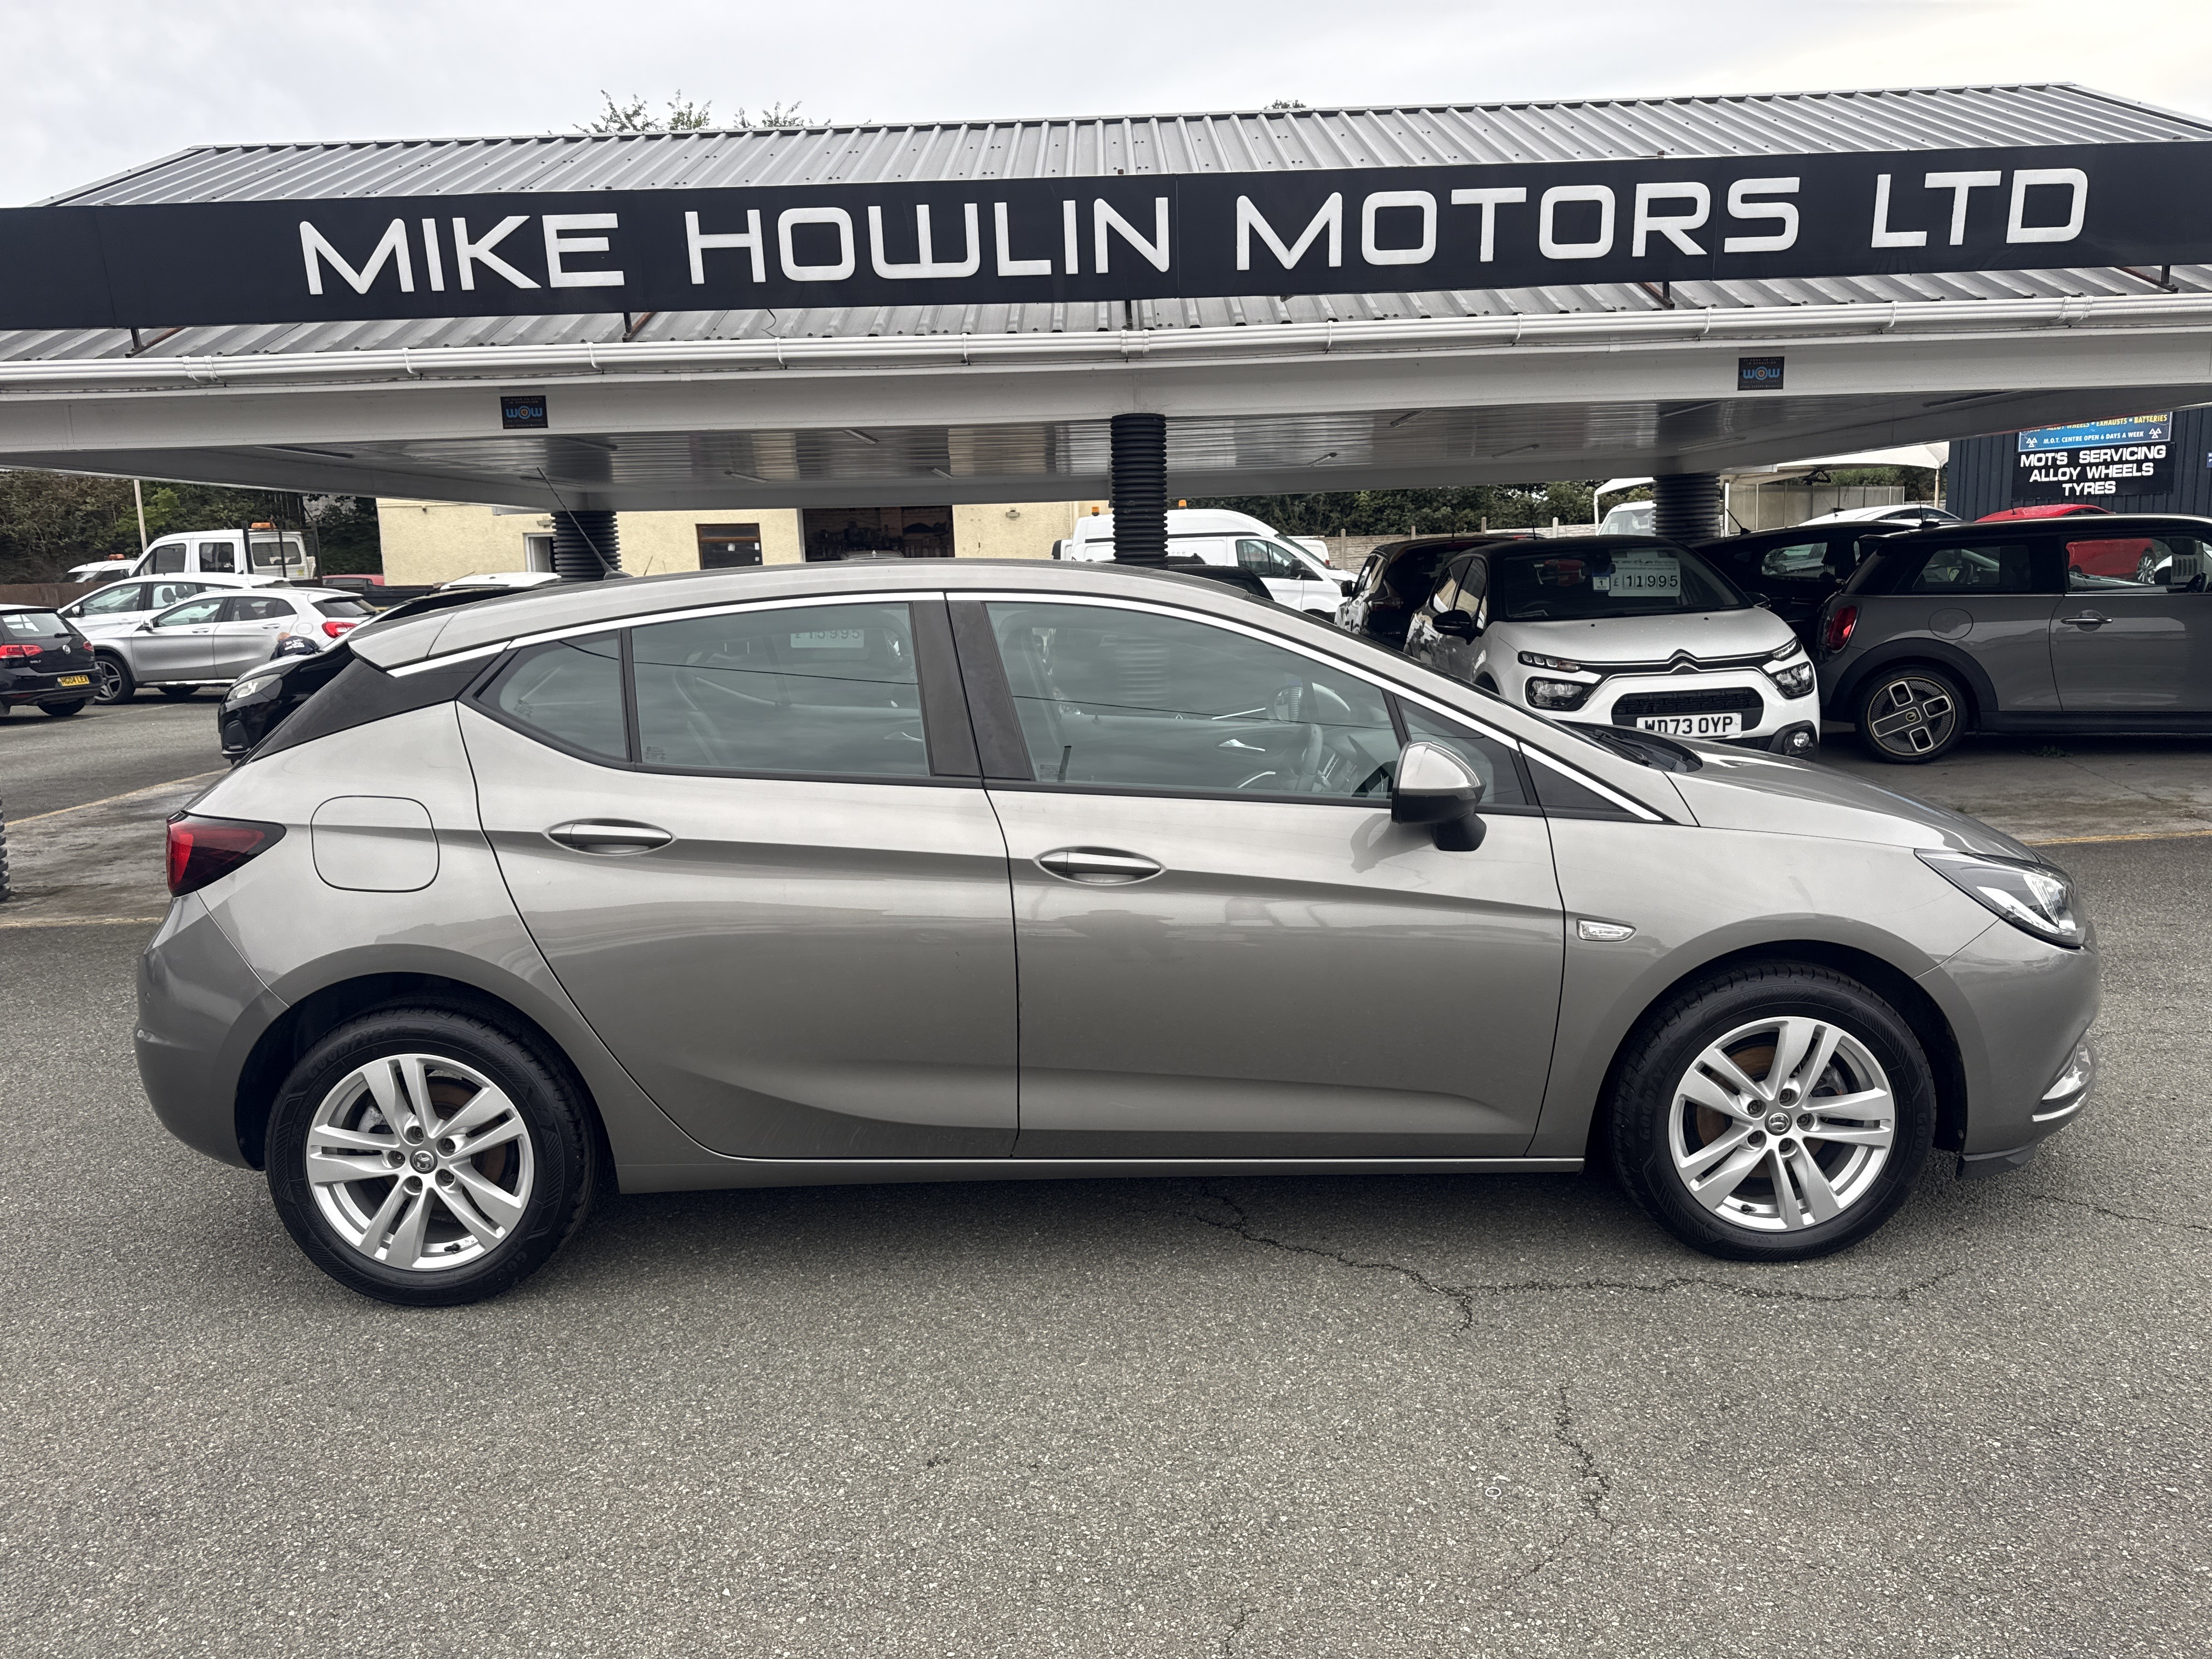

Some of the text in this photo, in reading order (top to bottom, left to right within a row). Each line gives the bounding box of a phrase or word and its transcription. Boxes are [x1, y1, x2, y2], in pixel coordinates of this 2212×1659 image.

[299, 168, 2088, 296] MIKE HOWLIN MOTORS LTD
[2096, 417, 2128, 427] EXHAUSTS
[2134, 414, 2168, 424] BATTERIES
[2020, 445, 2166, 467] MOT'S SERVICING
[2029, 462, 2154, 482] ALLOY WHEELS
[2062, 481, 2116, 496] TYRES
[1626, 575, 1678, 588] 11995
[1645, 716, 1733, 735] WD73 OYP
